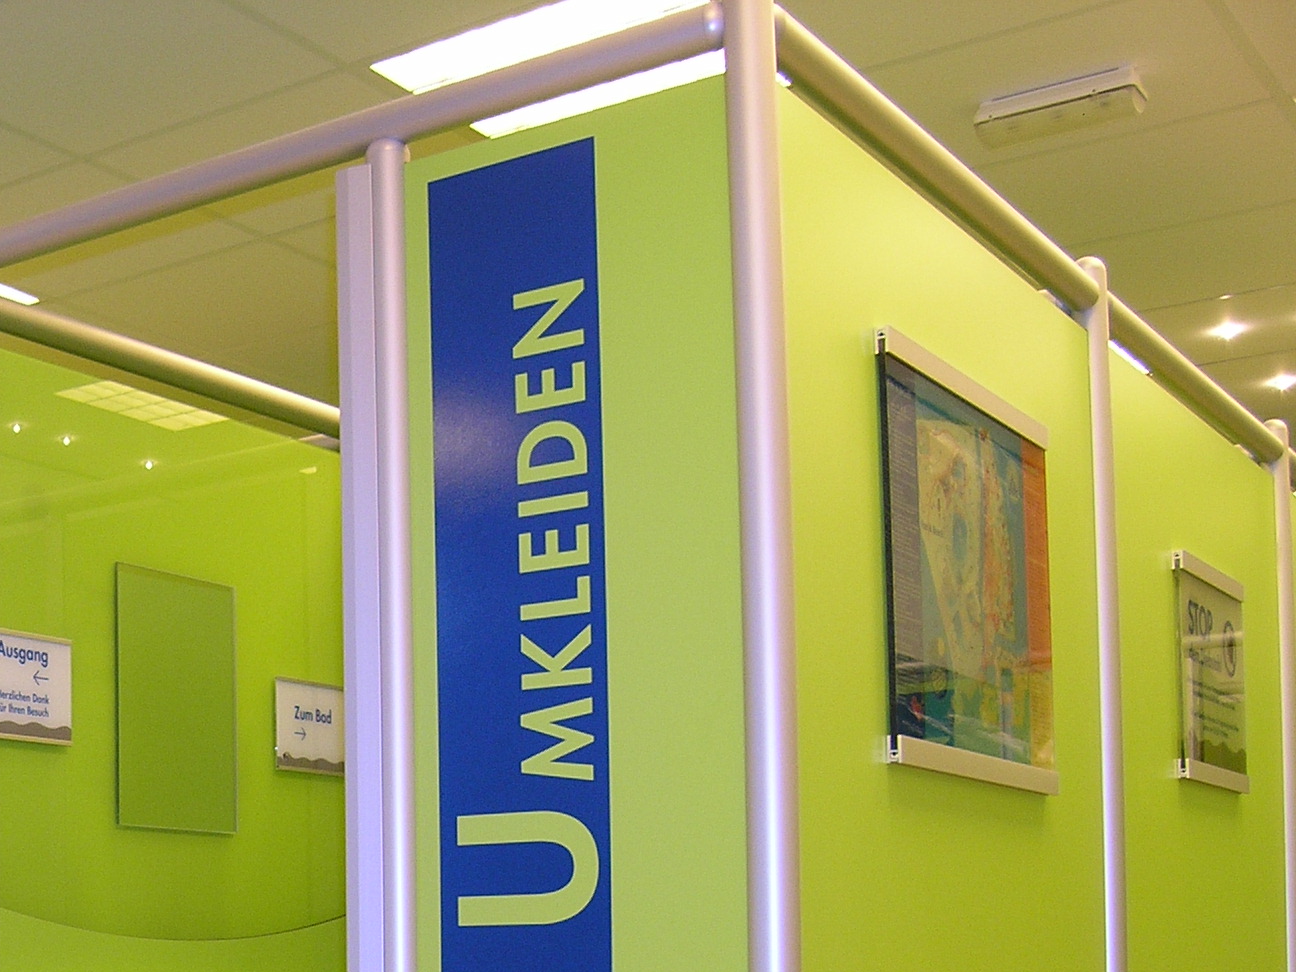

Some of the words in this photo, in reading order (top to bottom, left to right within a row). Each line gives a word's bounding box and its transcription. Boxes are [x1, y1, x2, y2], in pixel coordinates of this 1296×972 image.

[456, 278, 600, 928] UMKLEIDEN
[1188, 600, 1213, 640] STOP
[32, 693, 49, 704] Dank
[8, 703, 25, 714] Ihren
[27, 705, 49, 717] Besuch
[294, 705, 313, 721] Zum
[315, 708, 332, 724] Bad
